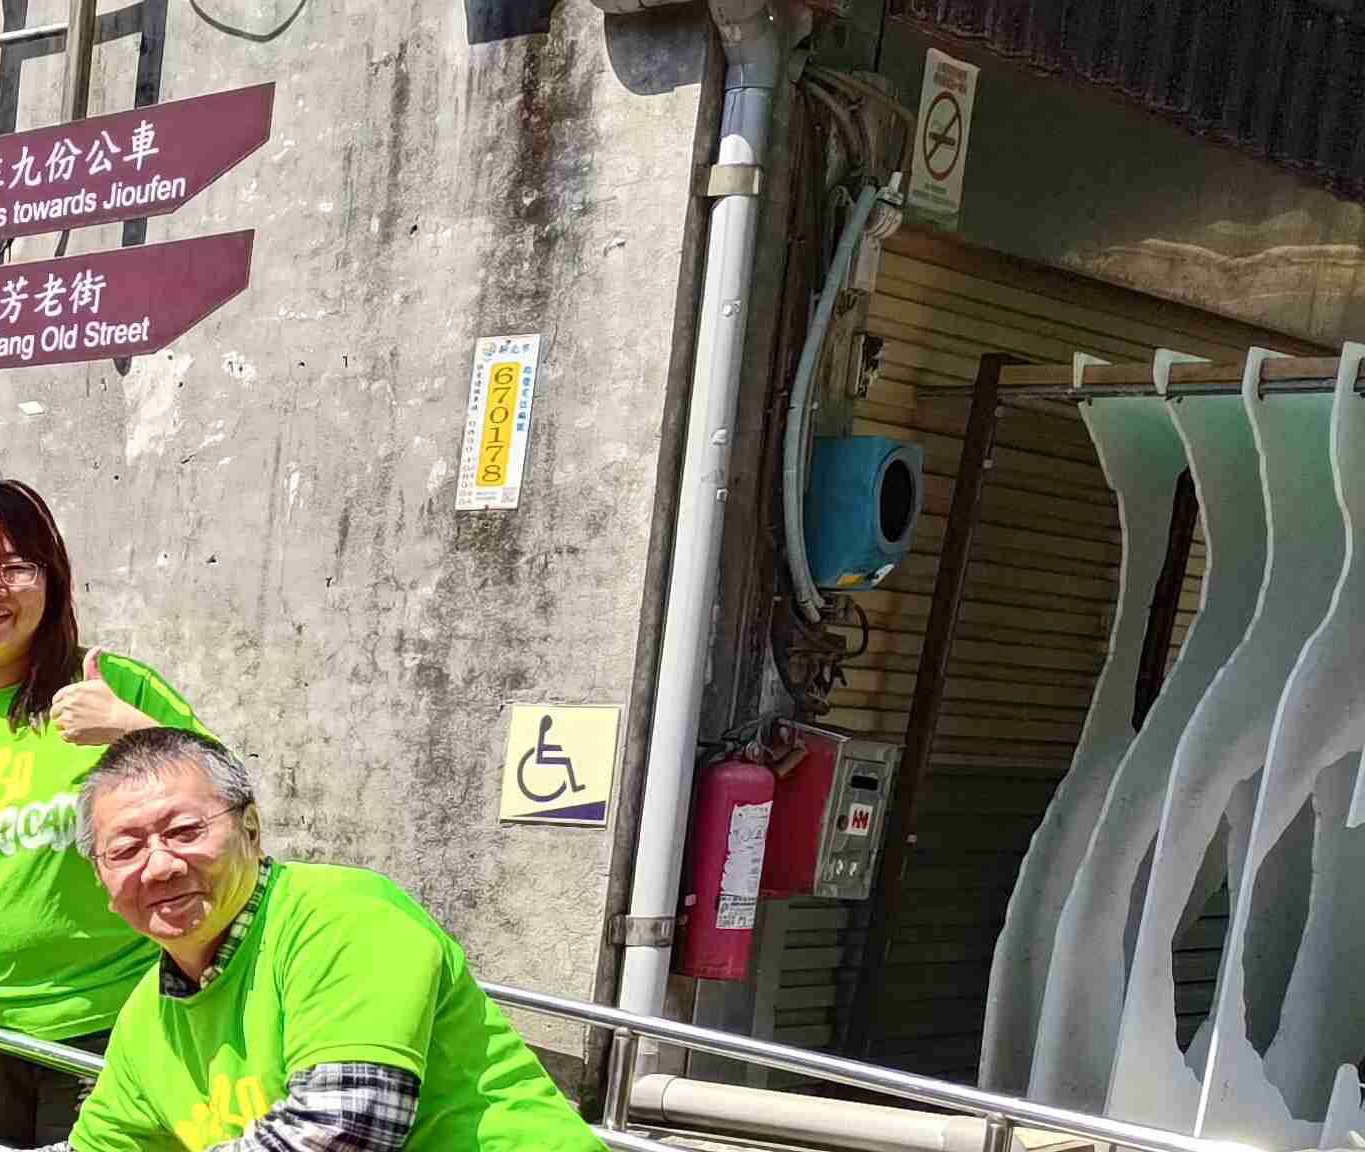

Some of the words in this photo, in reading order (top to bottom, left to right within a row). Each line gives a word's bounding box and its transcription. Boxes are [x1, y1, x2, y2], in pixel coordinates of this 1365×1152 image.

[13, 188, 97, 224] towards
[103, 174, 186, 210] Jioufen
[41, 324, 77, 351] Old
[83, 317, 149, 347] Street
[481, 366, 514, 483] 670178
